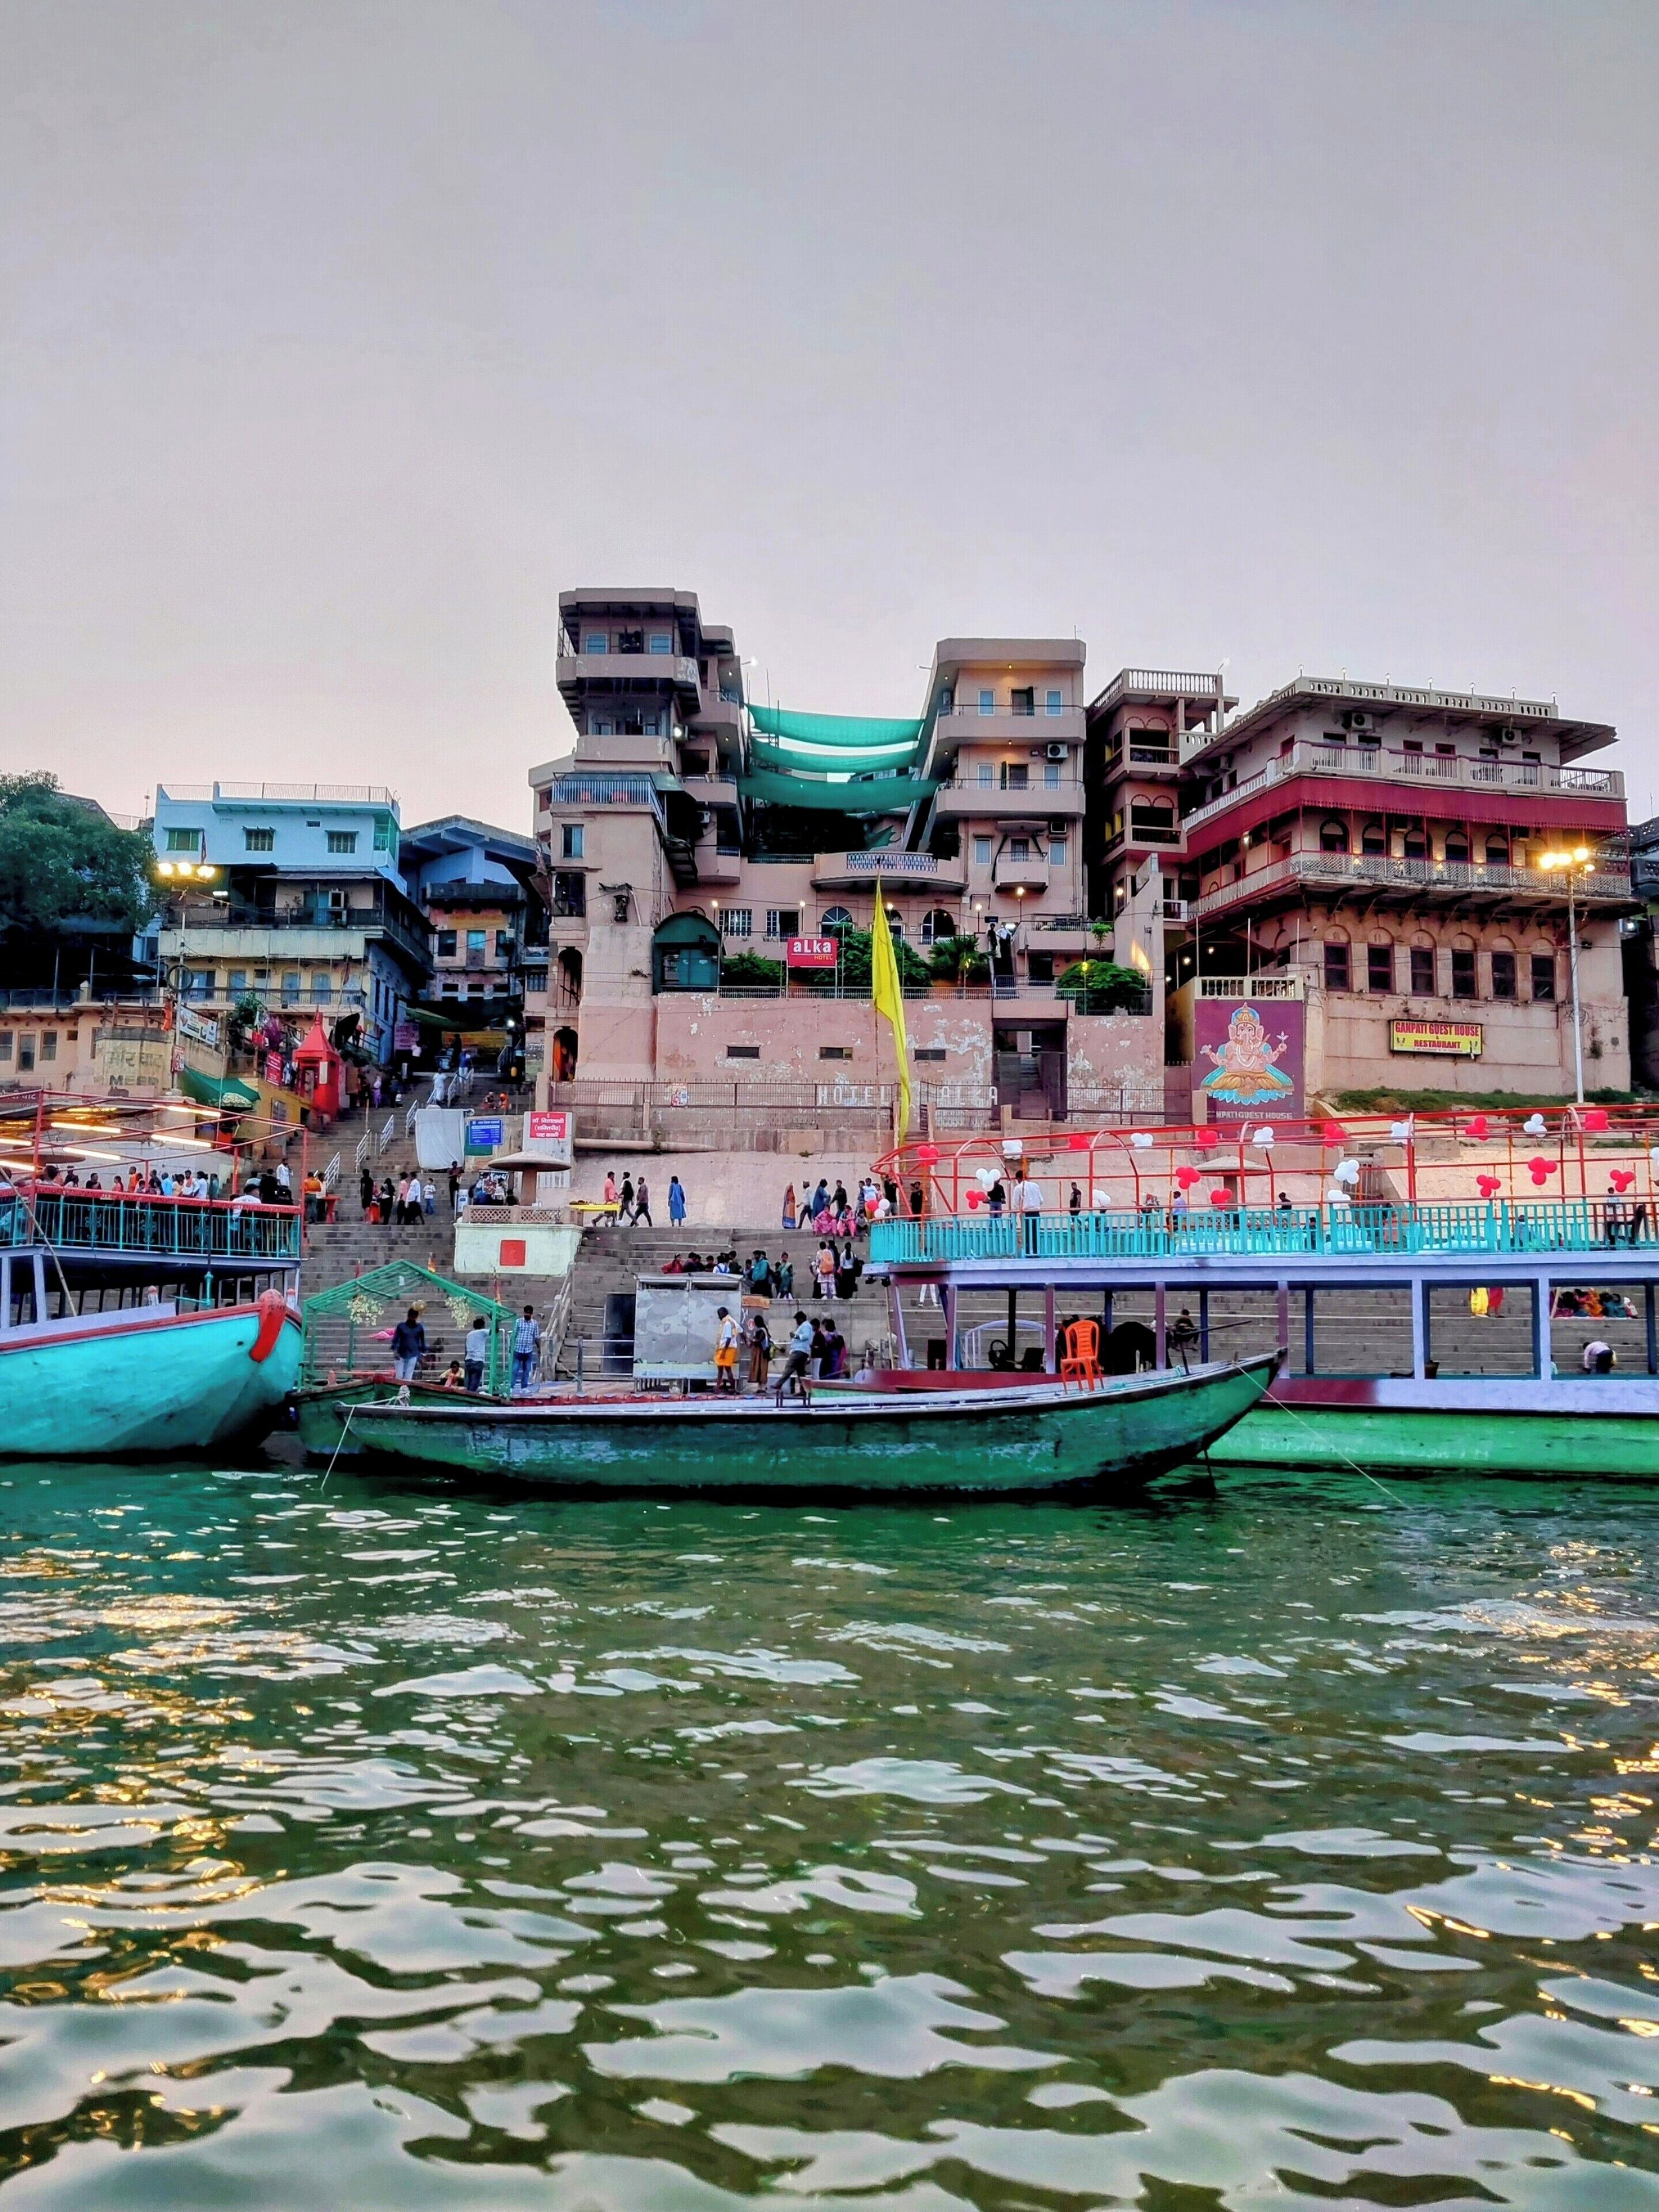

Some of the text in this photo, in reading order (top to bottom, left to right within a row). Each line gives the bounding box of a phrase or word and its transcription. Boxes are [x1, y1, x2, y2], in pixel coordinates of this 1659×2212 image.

[1395, 1022, 1479, 1036] GANPATI GUEST HOUSE
[1414, 1039, 1461, 1049] RESTAURANT
[818, 1086, 893, 1105] HOTEL
